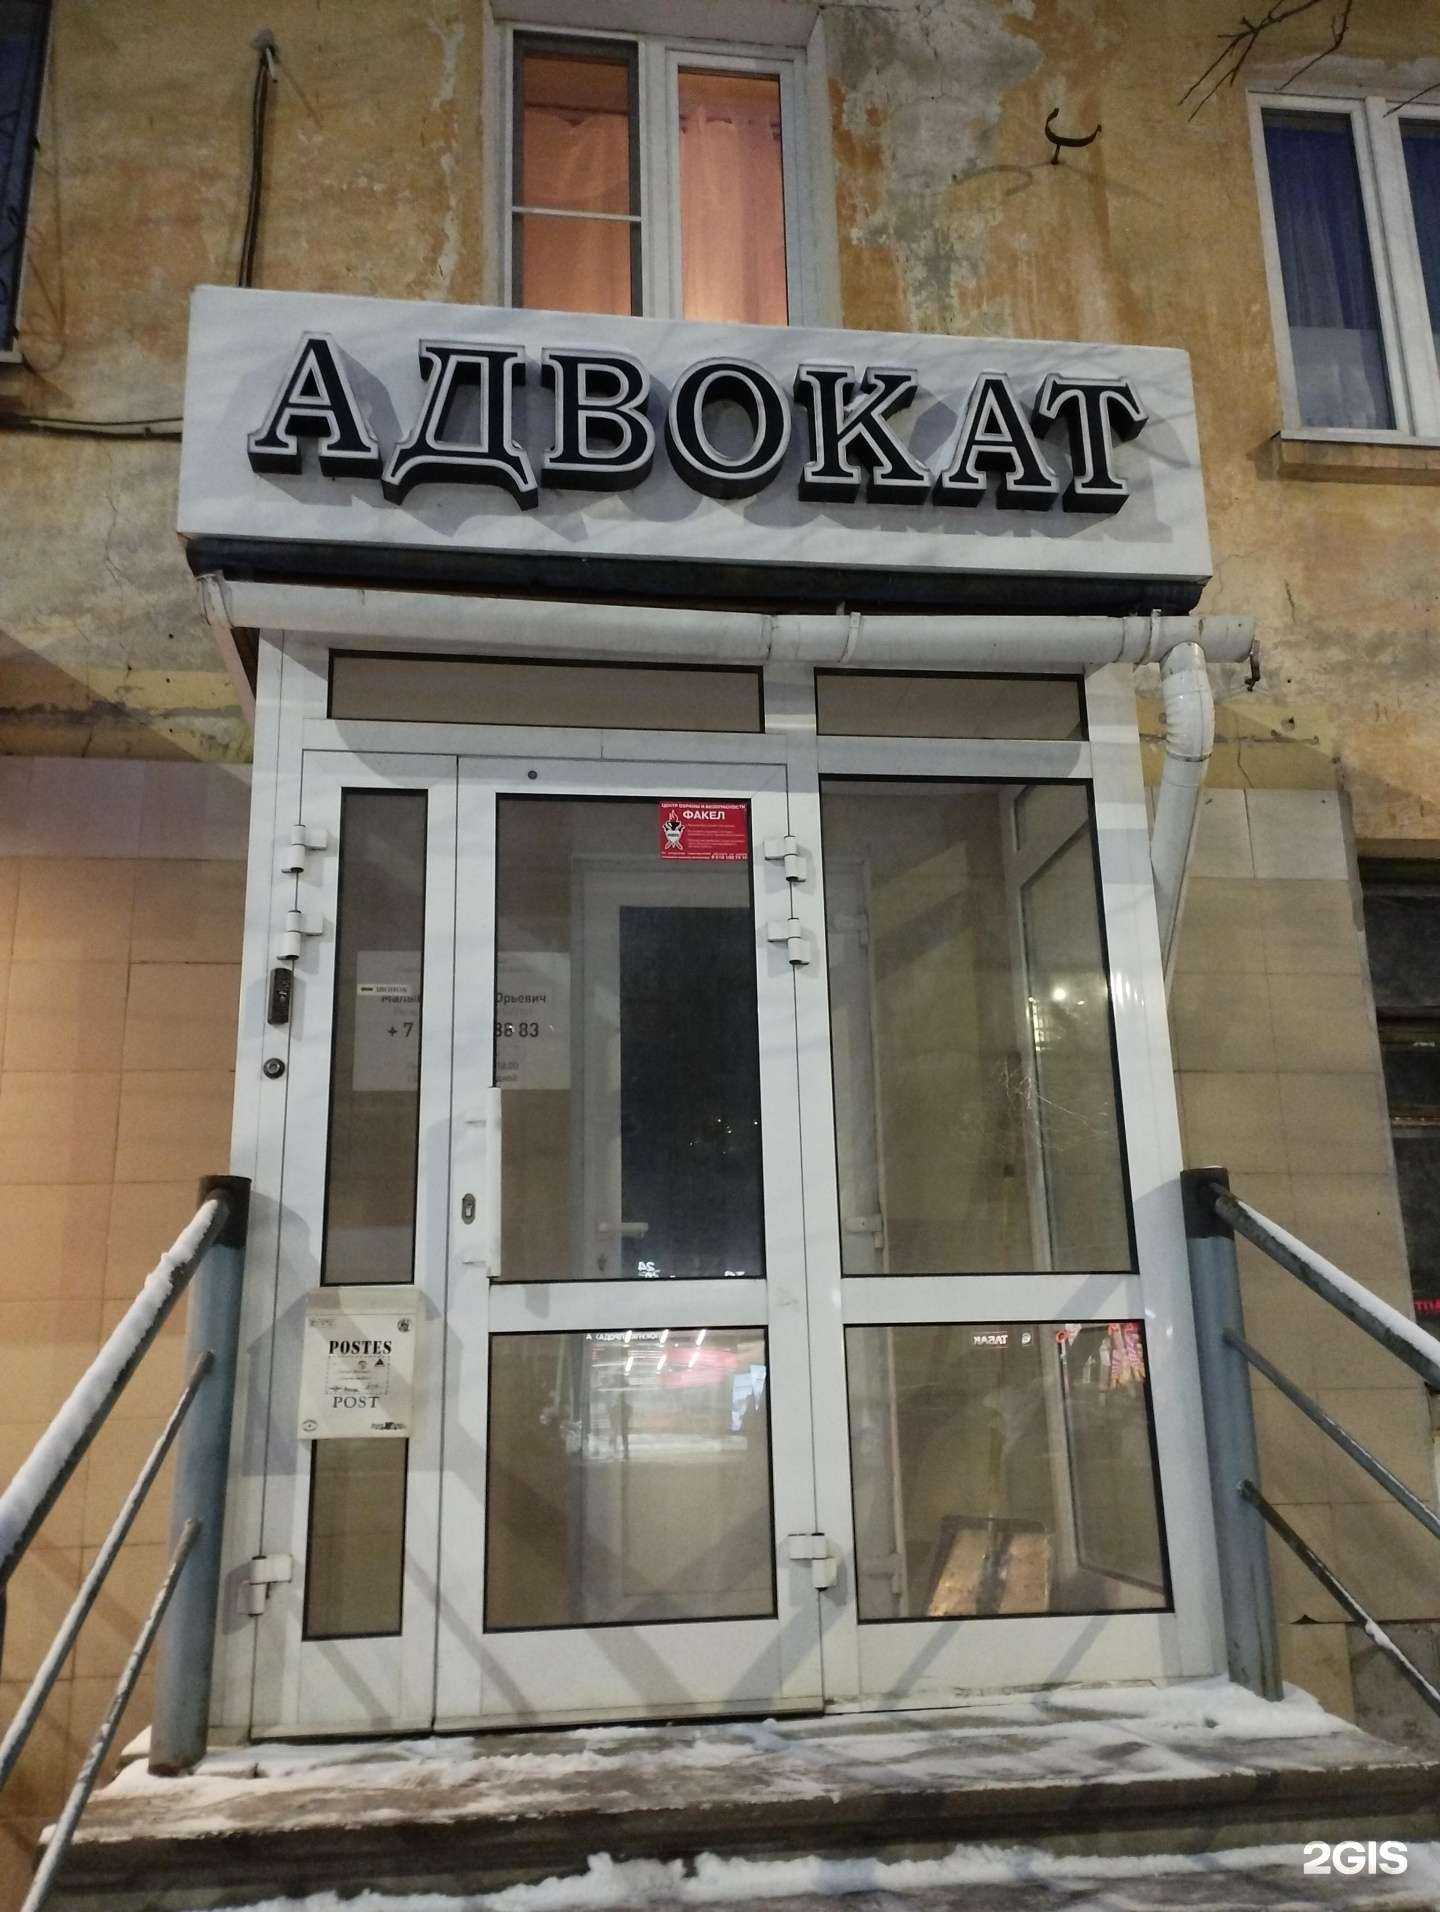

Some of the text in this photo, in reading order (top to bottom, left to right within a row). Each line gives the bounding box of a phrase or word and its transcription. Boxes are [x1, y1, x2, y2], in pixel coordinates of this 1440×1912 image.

[247, 330, 1147, 512] АДВОКАТ
[682, 810, 725, 820] ФАКЕЛ
[403, 1022, 414, 1038] 7
[519, 1022, 539, 1038] 83
[328, 1340, 393, 1355] POSTES
[332, 1396, 380, 1409] POST
